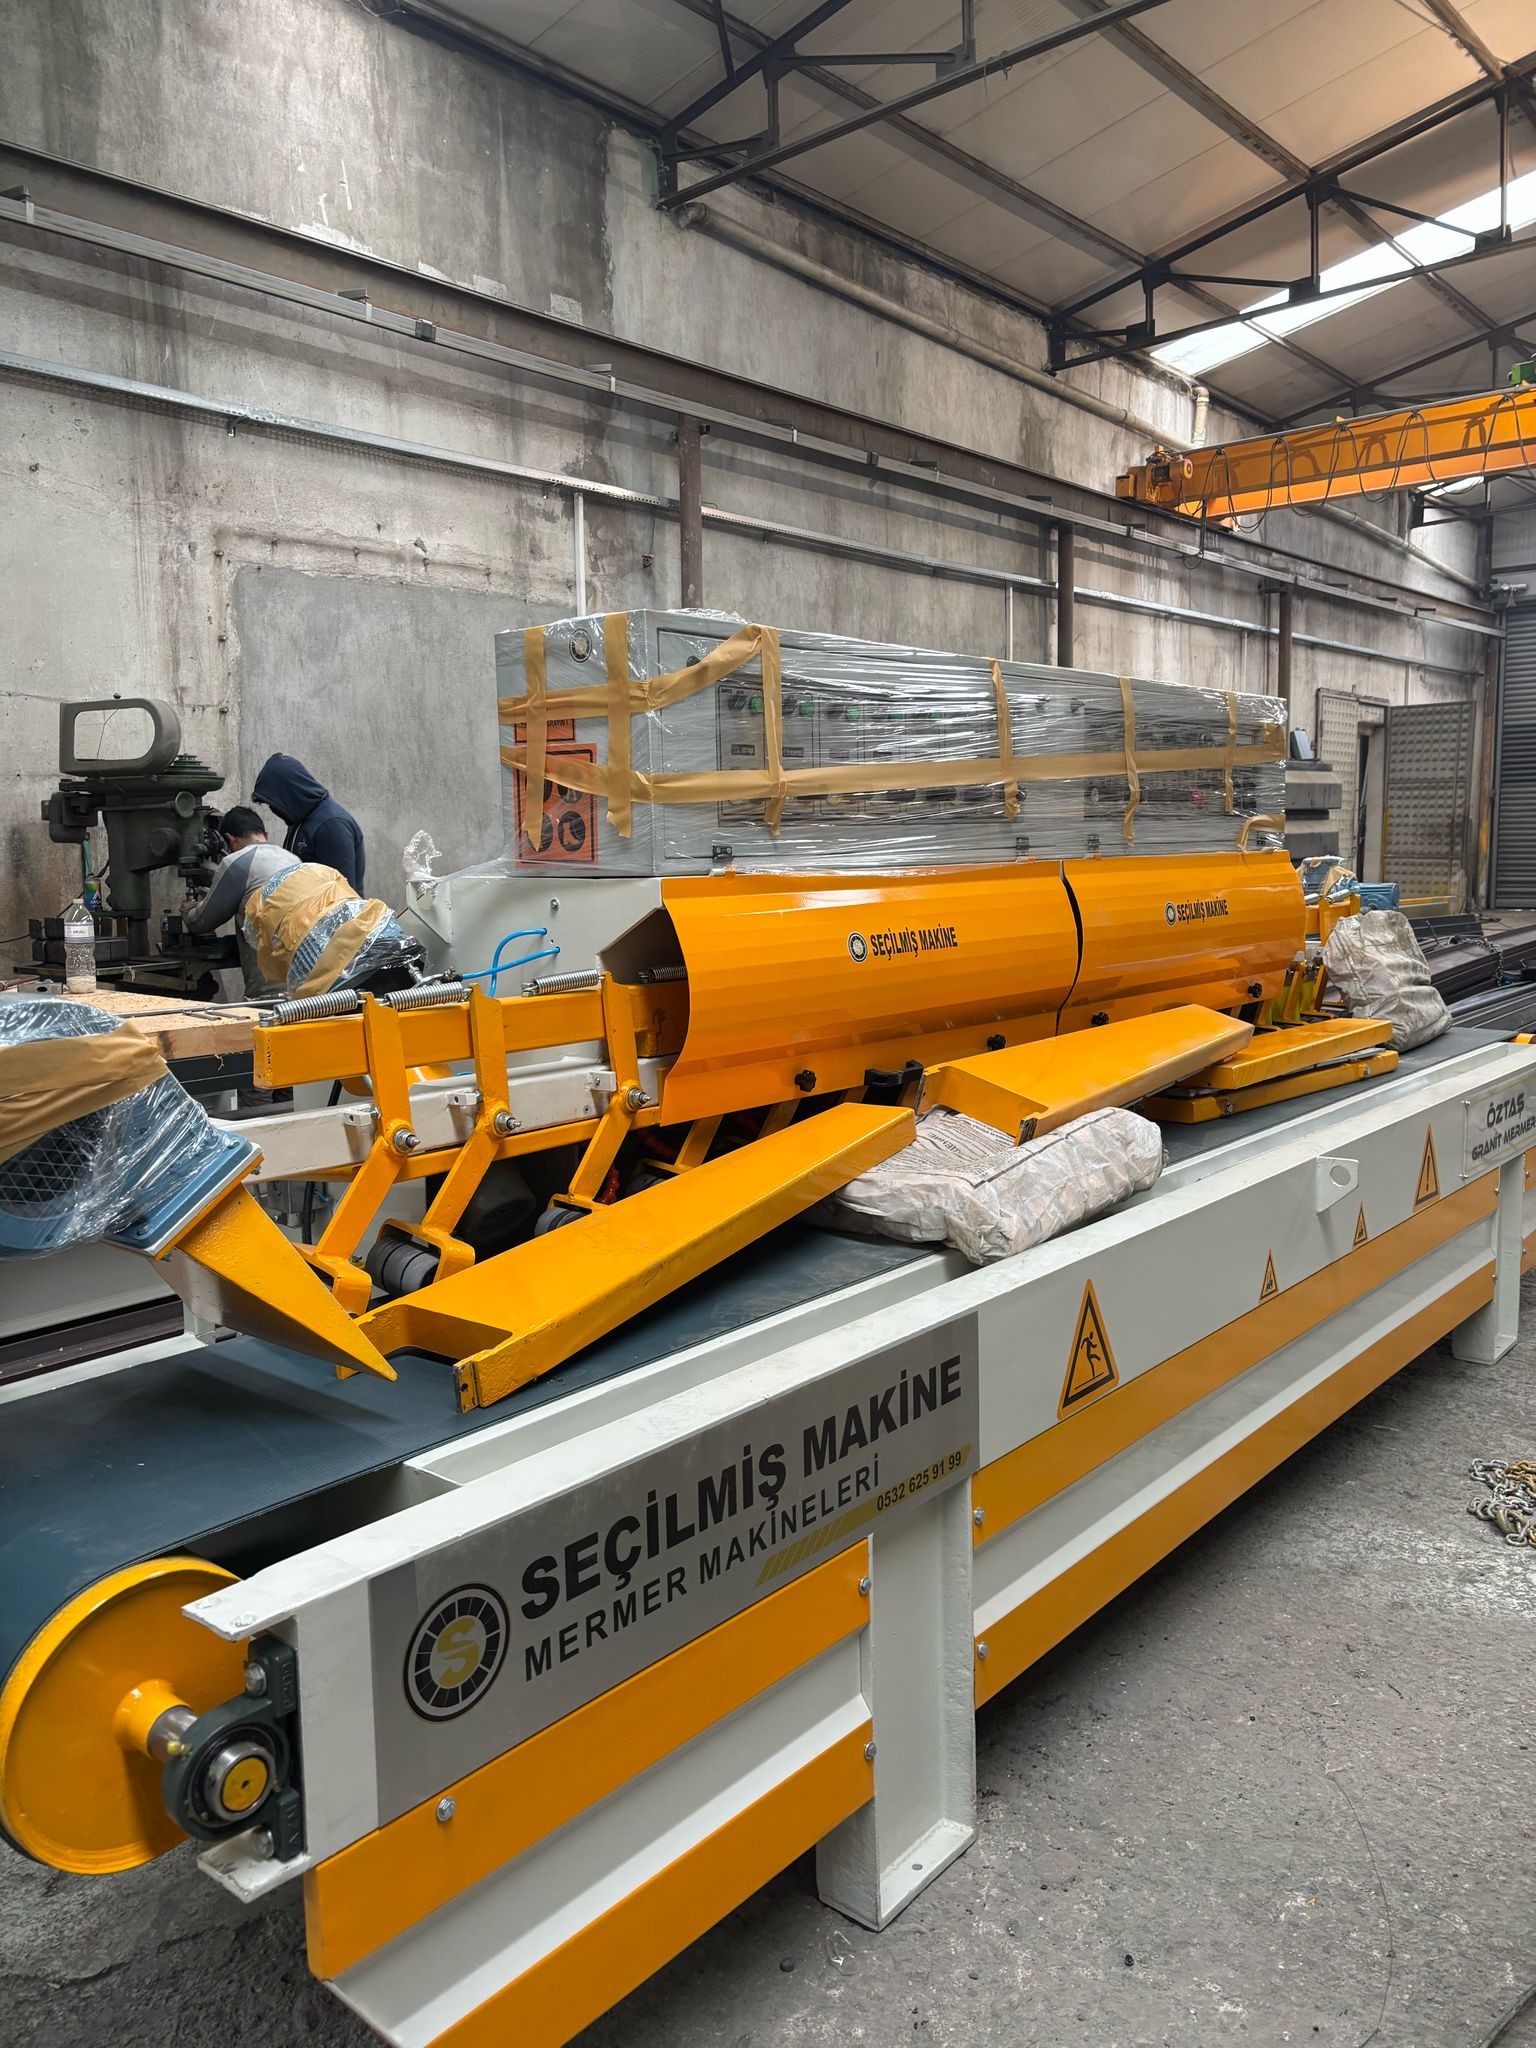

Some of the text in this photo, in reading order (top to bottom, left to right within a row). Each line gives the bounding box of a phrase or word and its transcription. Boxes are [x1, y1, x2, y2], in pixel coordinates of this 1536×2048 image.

[1205, 896, 1228, 918] MAKİNE
[870, 922, 958, 961] SEÇİLMİŞ MAKİNE
[1486, 1092, 1525, 1128] ÖZTAŞ
[1471, 1116, 1536, 1161] GRANİT MERMER
[521, 1355, 962, 1620] SEÇİLMİŞ MAKİNE
[876, 1450, 962, 1511] 0532 625 91 99
[525, 1452, 879, 1682] MERMER MAKİNELERİ
